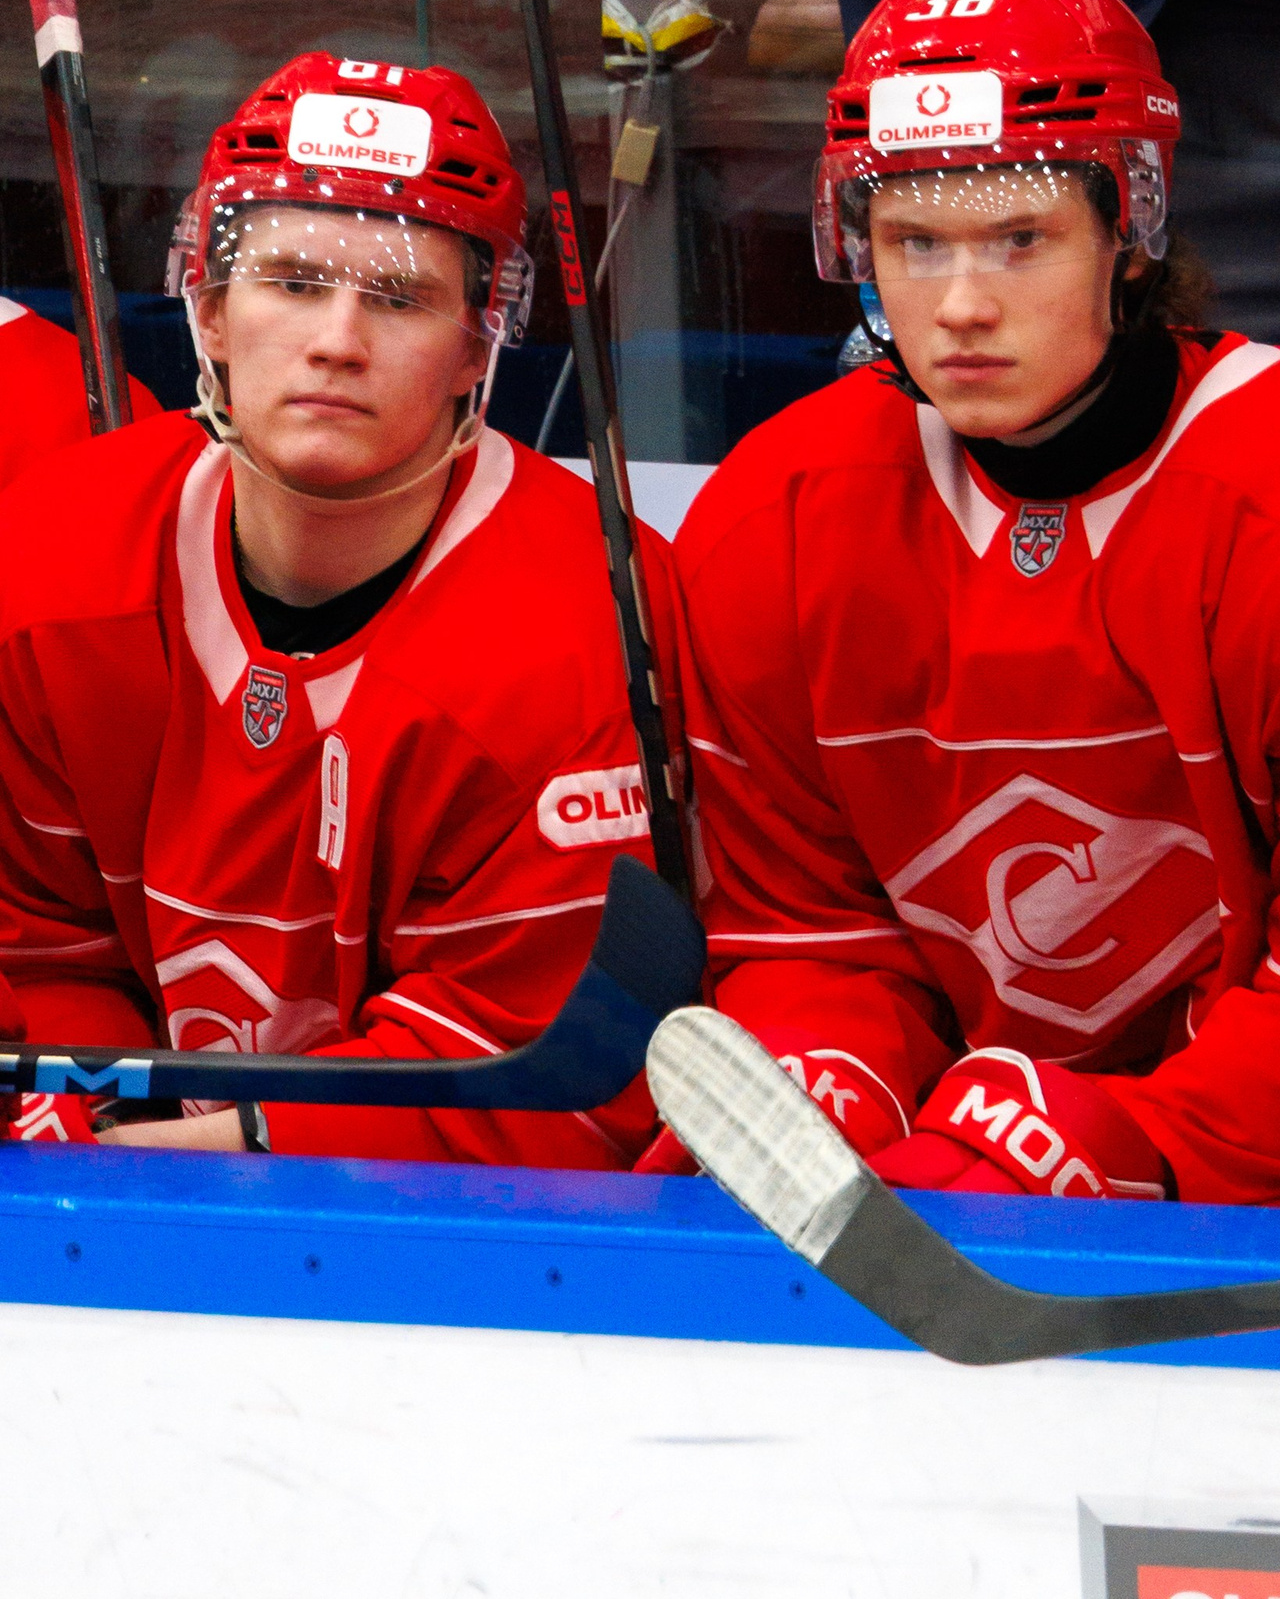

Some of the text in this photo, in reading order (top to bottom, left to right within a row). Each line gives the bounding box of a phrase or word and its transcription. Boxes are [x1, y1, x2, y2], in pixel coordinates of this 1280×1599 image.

[1146, 94, 1179, 118] CCM
[878, 122, 992, 144] OLIMPBET
[297, 142, 417, 168] OLIMPBET
[550, 202, 582, 296] CCM
[1020, 516, 1061, 529] МХЛ
[250, 681, 284, 702] МХЛ
[0, 1054, 153, 1099] M
